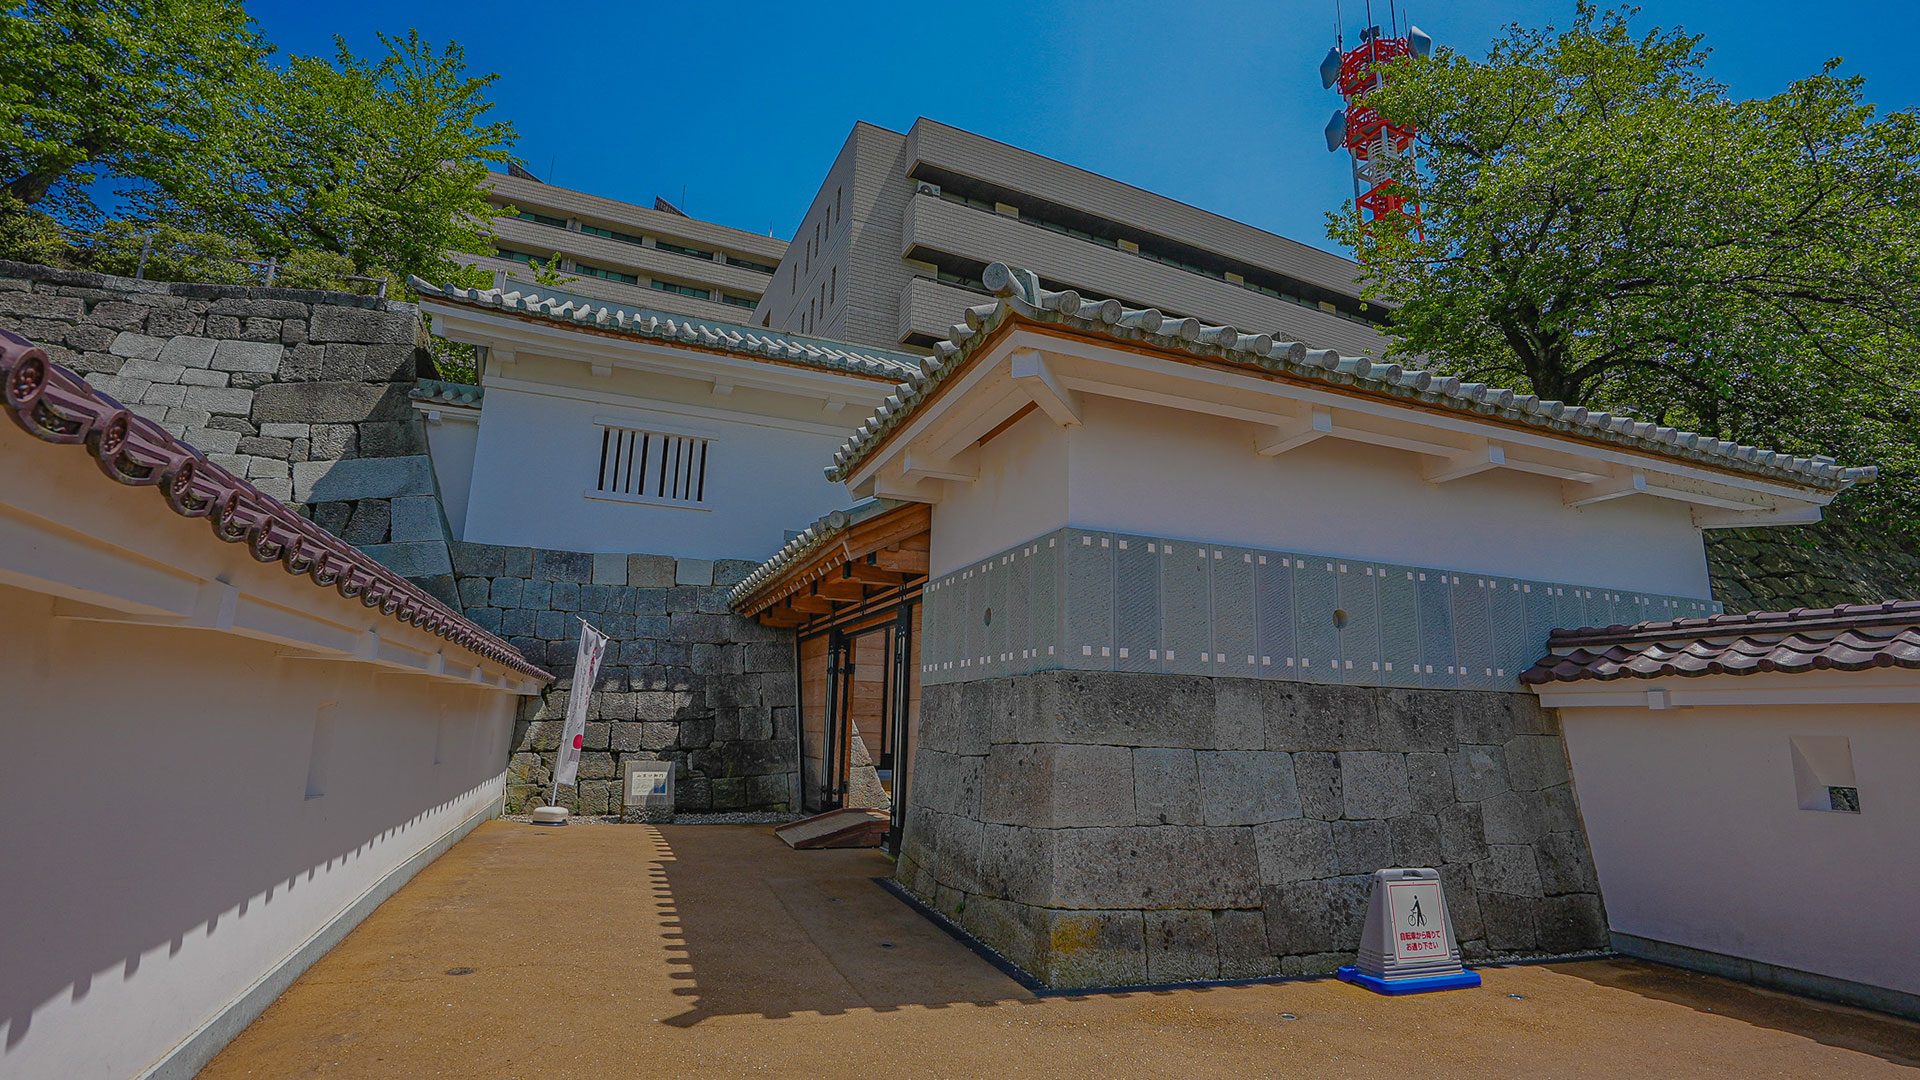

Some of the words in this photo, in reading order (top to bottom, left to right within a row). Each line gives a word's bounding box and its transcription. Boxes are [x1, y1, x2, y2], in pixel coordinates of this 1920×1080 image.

[1406, 942, 1439, 951] お通り下さい
